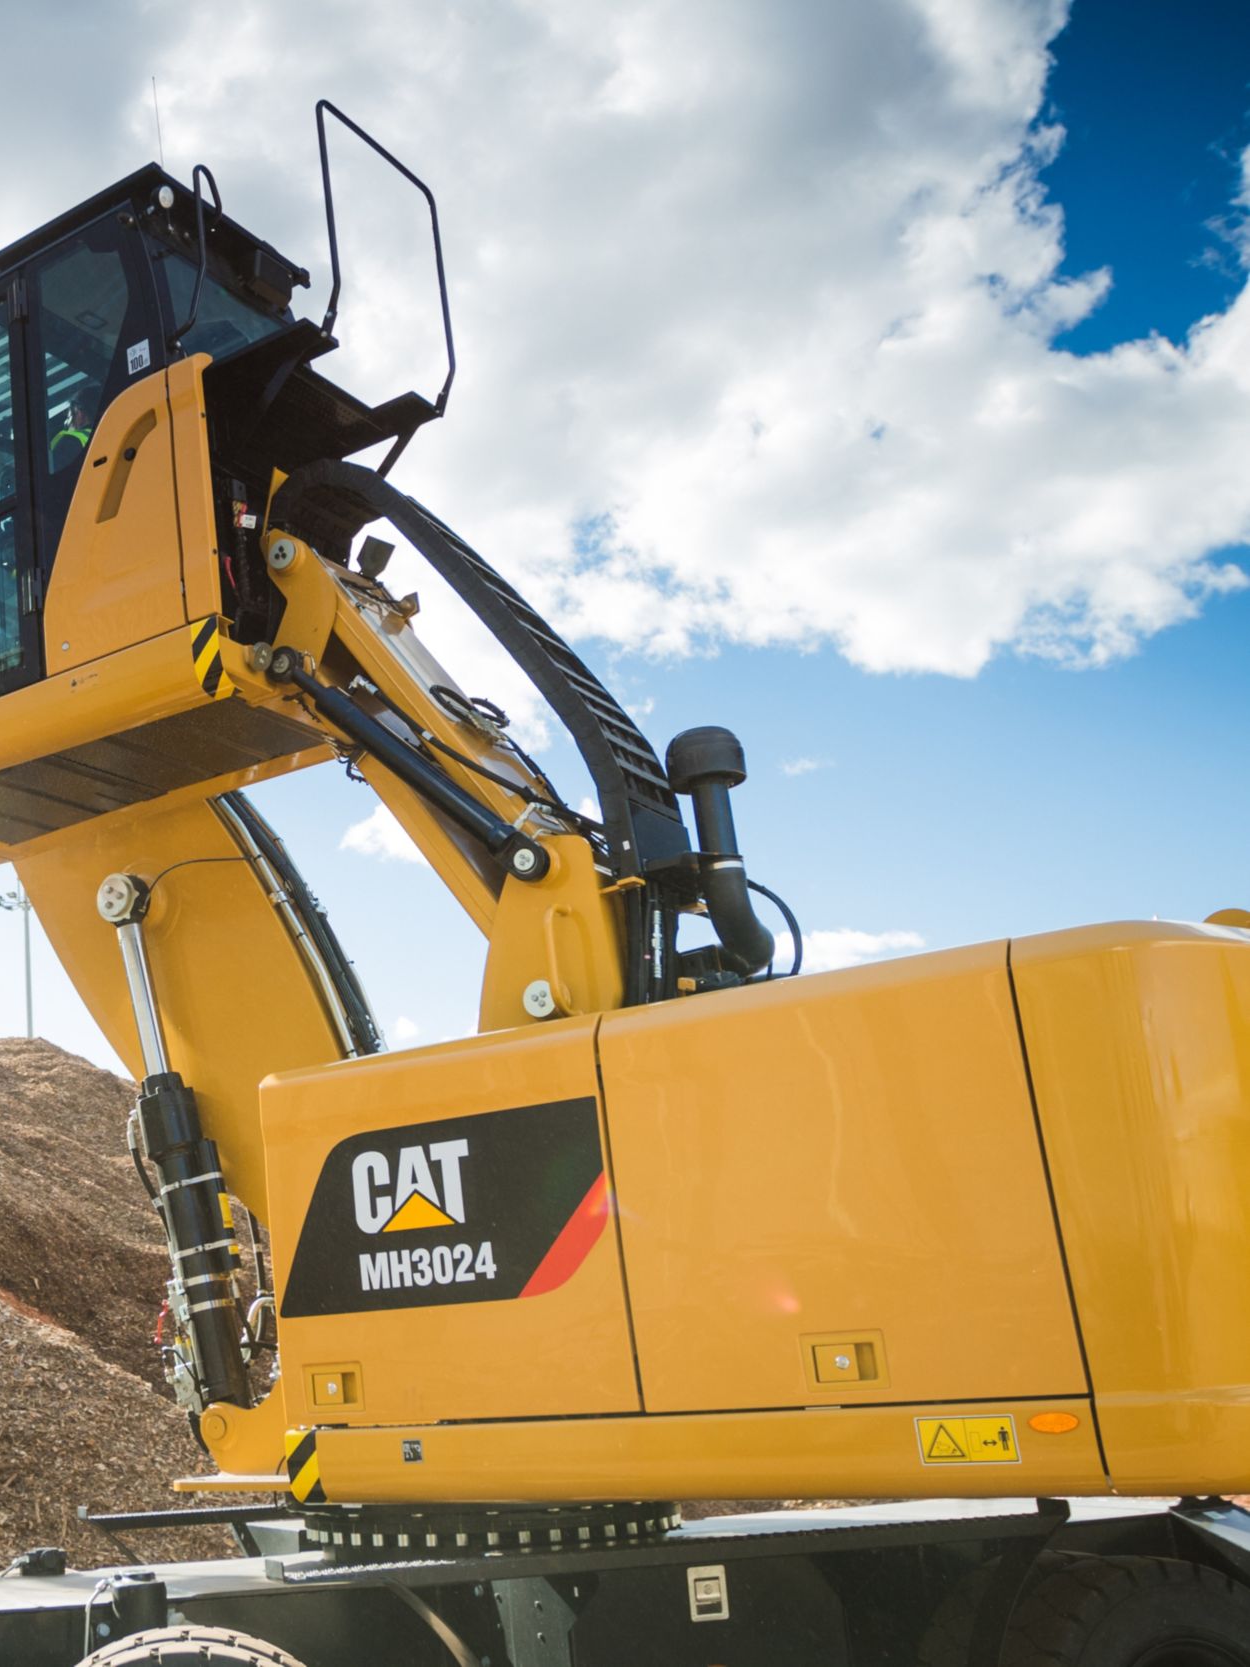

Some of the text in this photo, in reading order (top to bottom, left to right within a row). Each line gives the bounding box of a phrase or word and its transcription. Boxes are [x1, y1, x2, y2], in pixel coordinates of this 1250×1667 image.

[130, 354, 143, 371] 100
[352, 1138, 469, 1234] CAT
[359, 1241, 497, 1291] MH3024
